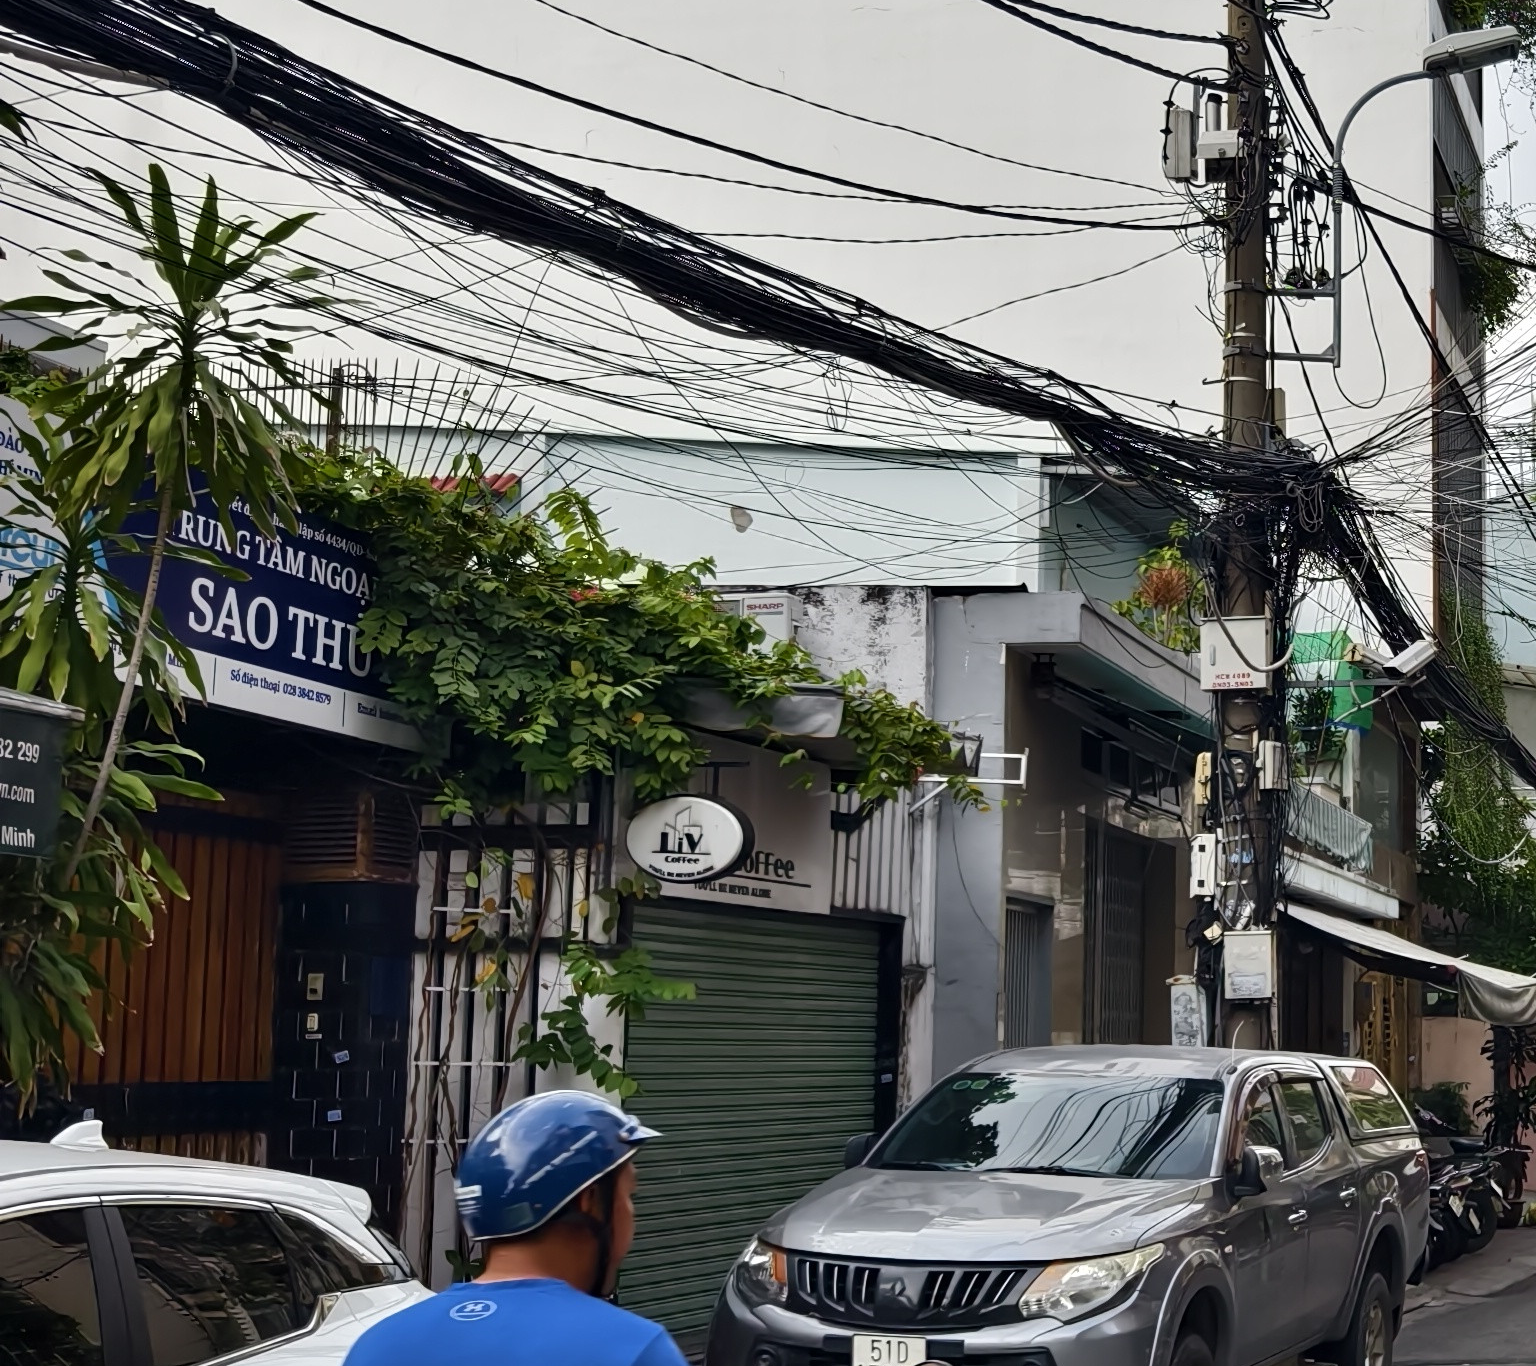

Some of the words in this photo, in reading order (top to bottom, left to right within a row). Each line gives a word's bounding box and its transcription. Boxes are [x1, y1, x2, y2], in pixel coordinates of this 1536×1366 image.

[172, 509, 251, 560] RUNG
[255, 535, 306, 579] TÂM
[188, 577, 279, 651] SAO
[746, 602, 784, 610] SHARP
[17, 741, 40, 764] 299
[1, 825, 35, 848] Minh
[740, 850, 795, 879] offee
[870, 1339, 908, 1364] 51D
